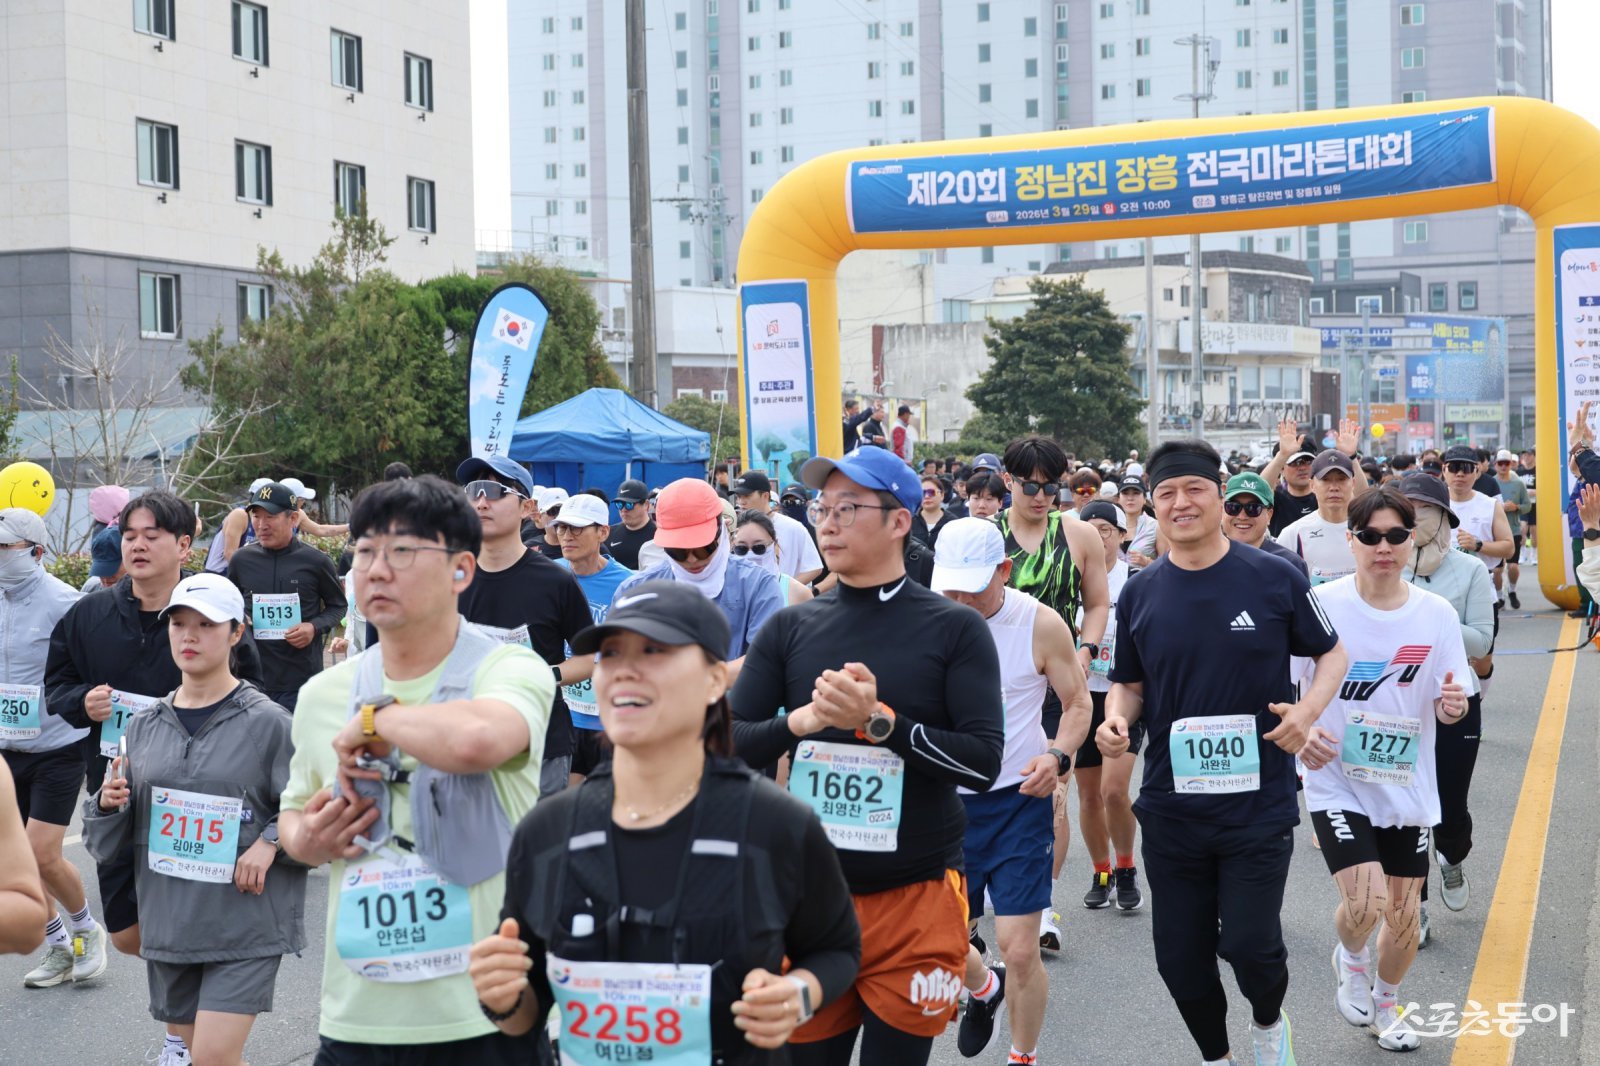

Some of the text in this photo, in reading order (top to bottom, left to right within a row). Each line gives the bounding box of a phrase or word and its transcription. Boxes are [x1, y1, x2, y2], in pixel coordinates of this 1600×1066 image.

[907, 130, 1412, 206] 제20회 정남진 장흥 전국마라톤대회
[1220, 193, 1246, 205] 장흥군
[1248, 190, 1283, 202] 탐진강변
[1284, 189, 1294, 199] 및
[1295, 186, 1321, 198] 장흥댐
[1323, 183, 1341, 195] 일원
[1016, 208, 1049, 220] 2026년
[1052, 205, 1070, 217] 3월
[1073, 204, 1099, 216] 29일
[1104, 203, 1114, 214] 일
[1120, 202, 1139, 213] 오전
[1142, 200, 1171, 211] 10:00
[259, 606, 293, 619] 1513
[1184, 736, 1245, 759] 1040
[1359, 731, 1411, 755] 1277
[1368, 752, 1395, 764] 김도영
[808, 770, 883, 804] 1662
[183, 808, 203, 817] 10km
[822, 800, 862, 818] 최영찬
[160, 812, 224, 844] 2115
[173, 838, 205, 855] 김아영
[358, 887, 448, 929] 1013
[376, 925, 426, 947] 안현섭
[566, 1000, 683, 1046] 2258
